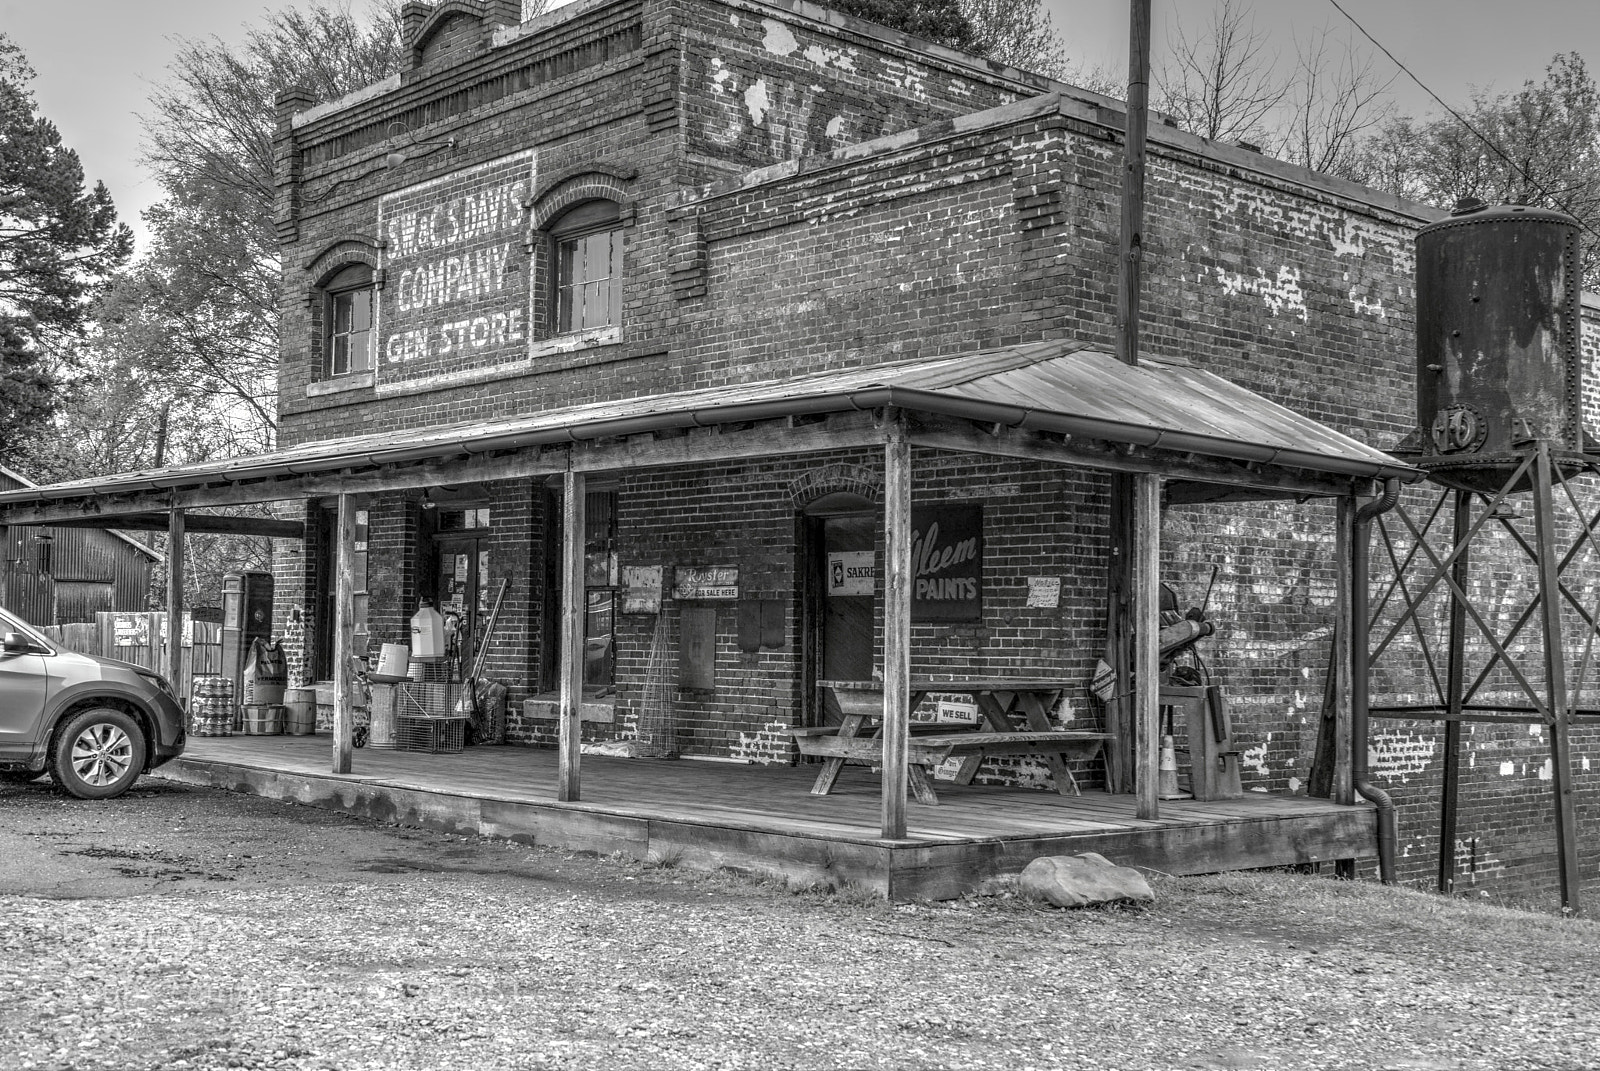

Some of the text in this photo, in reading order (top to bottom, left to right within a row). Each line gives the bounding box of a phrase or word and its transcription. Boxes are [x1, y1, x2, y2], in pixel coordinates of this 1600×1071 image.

[464, 182, 523, 239] DAVIS
[399, 242, 509, 311] COMPANY
[440, 309, 521, 353] STORE
[685, 568, 729, 583] Royster
[695, 588, 736, 597] FOR SALE HERE
[916, 577, 976, 600] PAINTS
[942, 709, 972, 721] WE SELL
